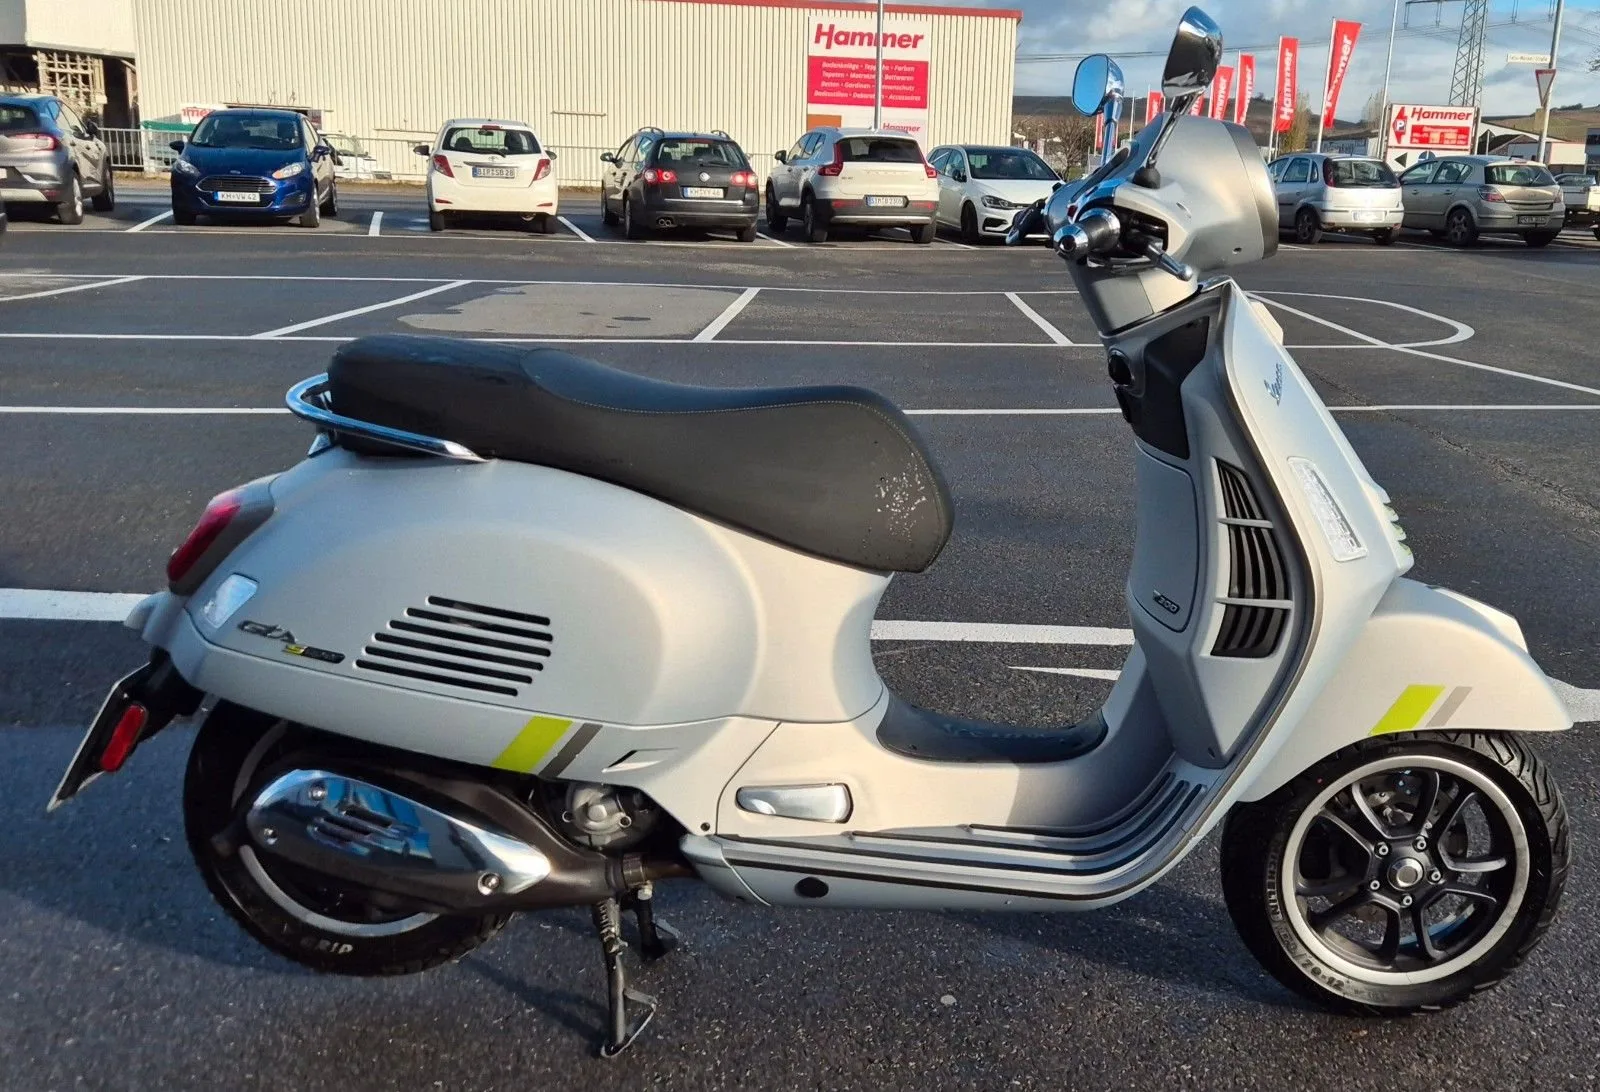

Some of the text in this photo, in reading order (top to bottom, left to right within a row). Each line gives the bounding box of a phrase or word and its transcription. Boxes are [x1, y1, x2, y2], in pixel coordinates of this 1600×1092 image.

[814, 23, 924, 50] Hammer
[864, 63, 890, 72] Tepphe
[1280, 47, 1295, 121] Hammer
[1411, 107, 1472, 121] Hammer
